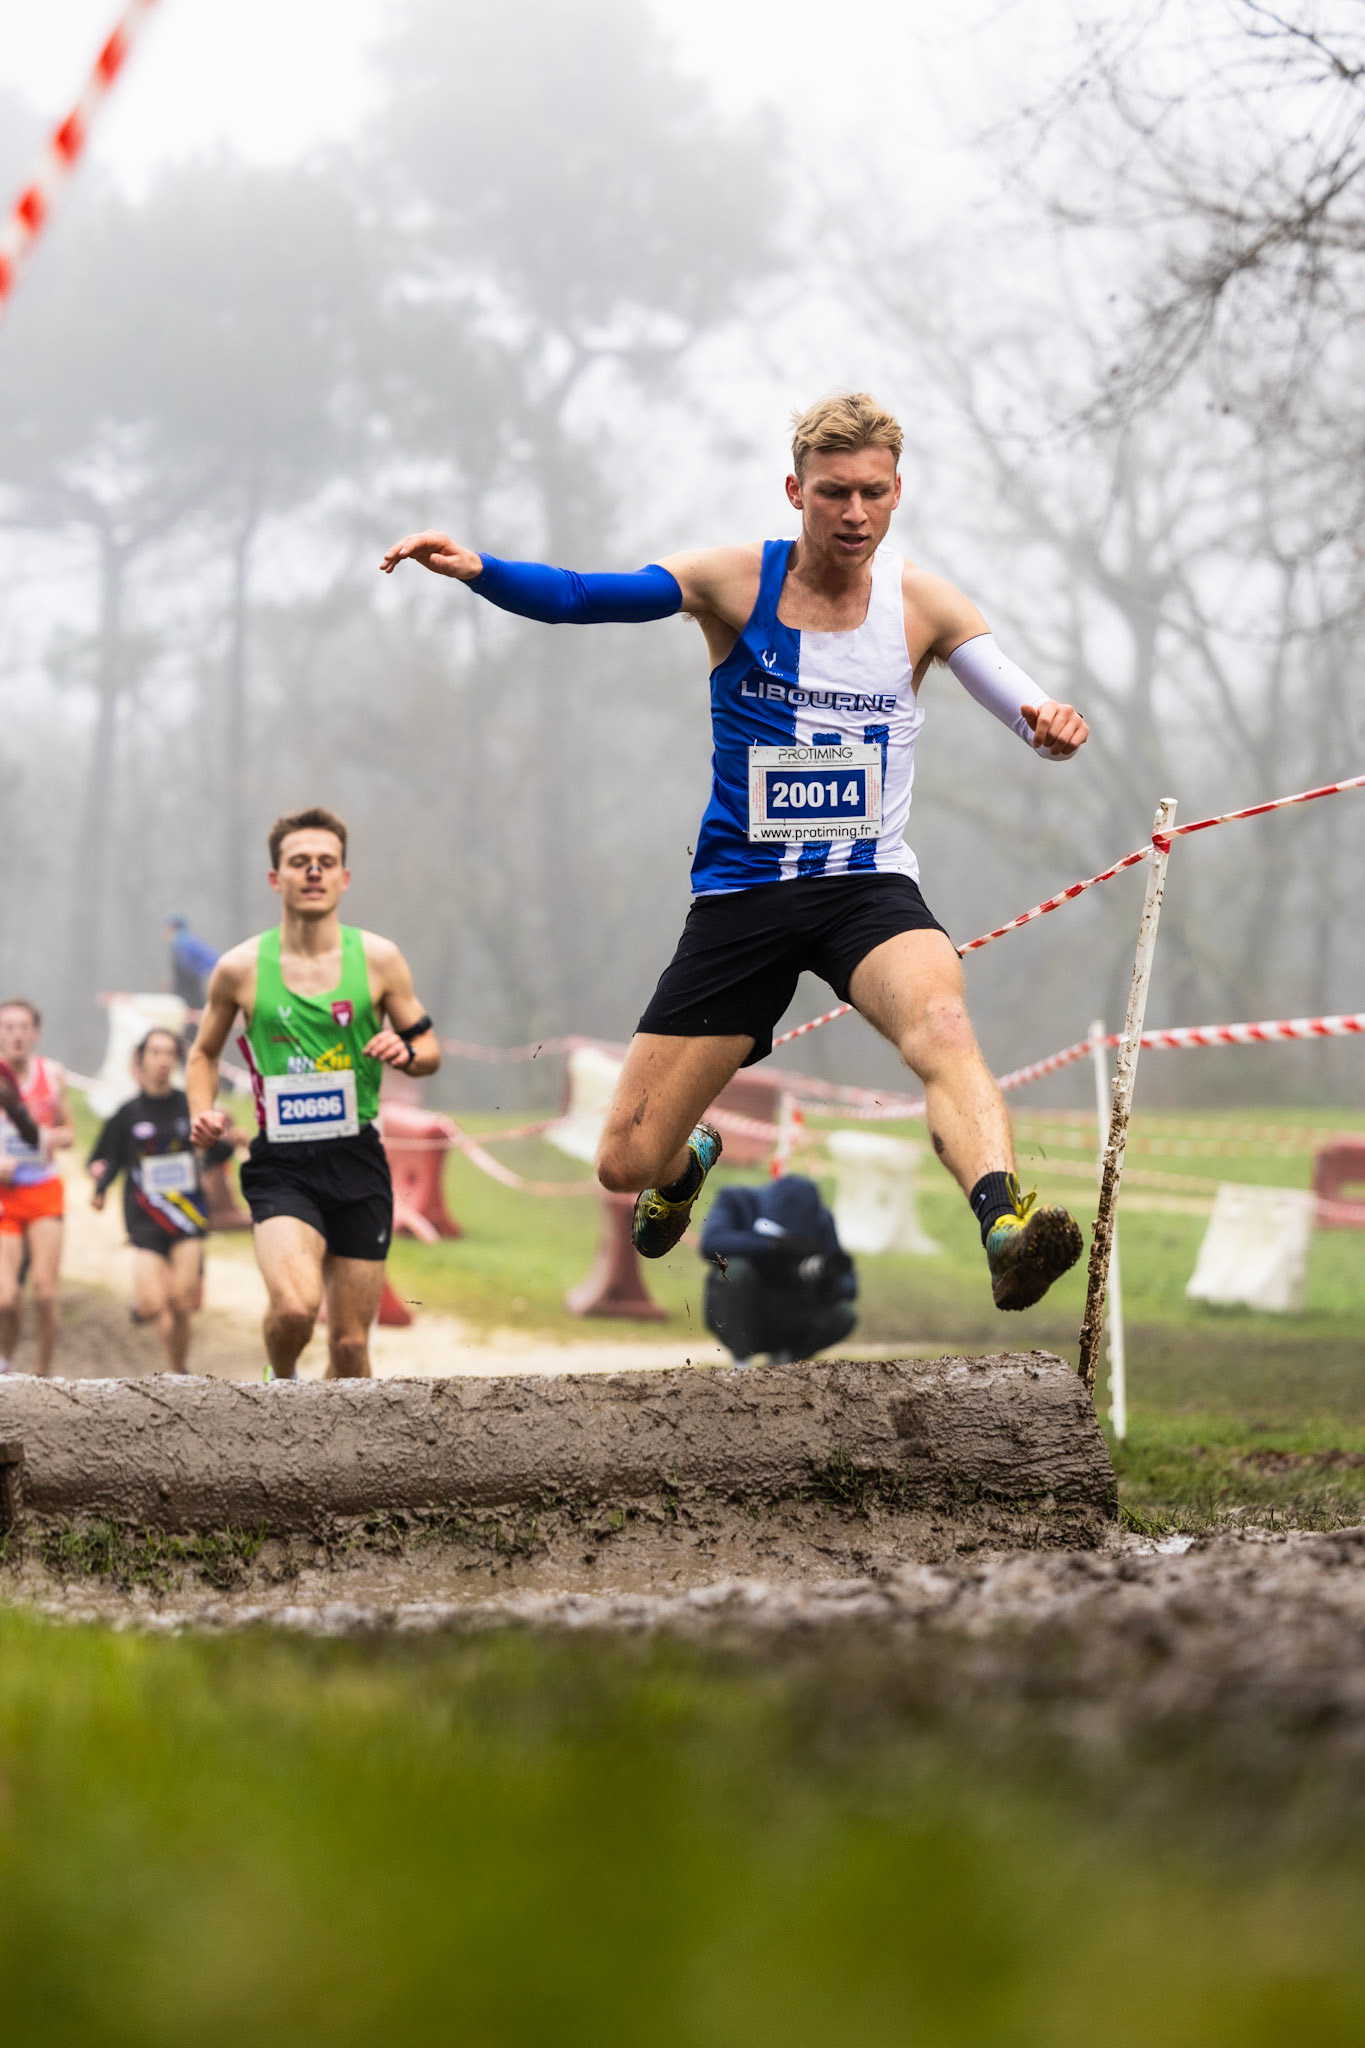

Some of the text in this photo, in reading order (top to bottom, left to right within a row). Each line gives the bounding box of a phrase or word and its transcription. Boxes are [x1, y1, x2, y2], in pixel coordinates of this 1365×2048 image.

[740, 680, 897, 712] LIBOURNE
[778, 746, 853, 760] PROTIMING
[772, 781, 860, 808] 20014
[760, 824, 871, 841] www.protiming.fr
[280, 1095, 342, 1120] 20696
